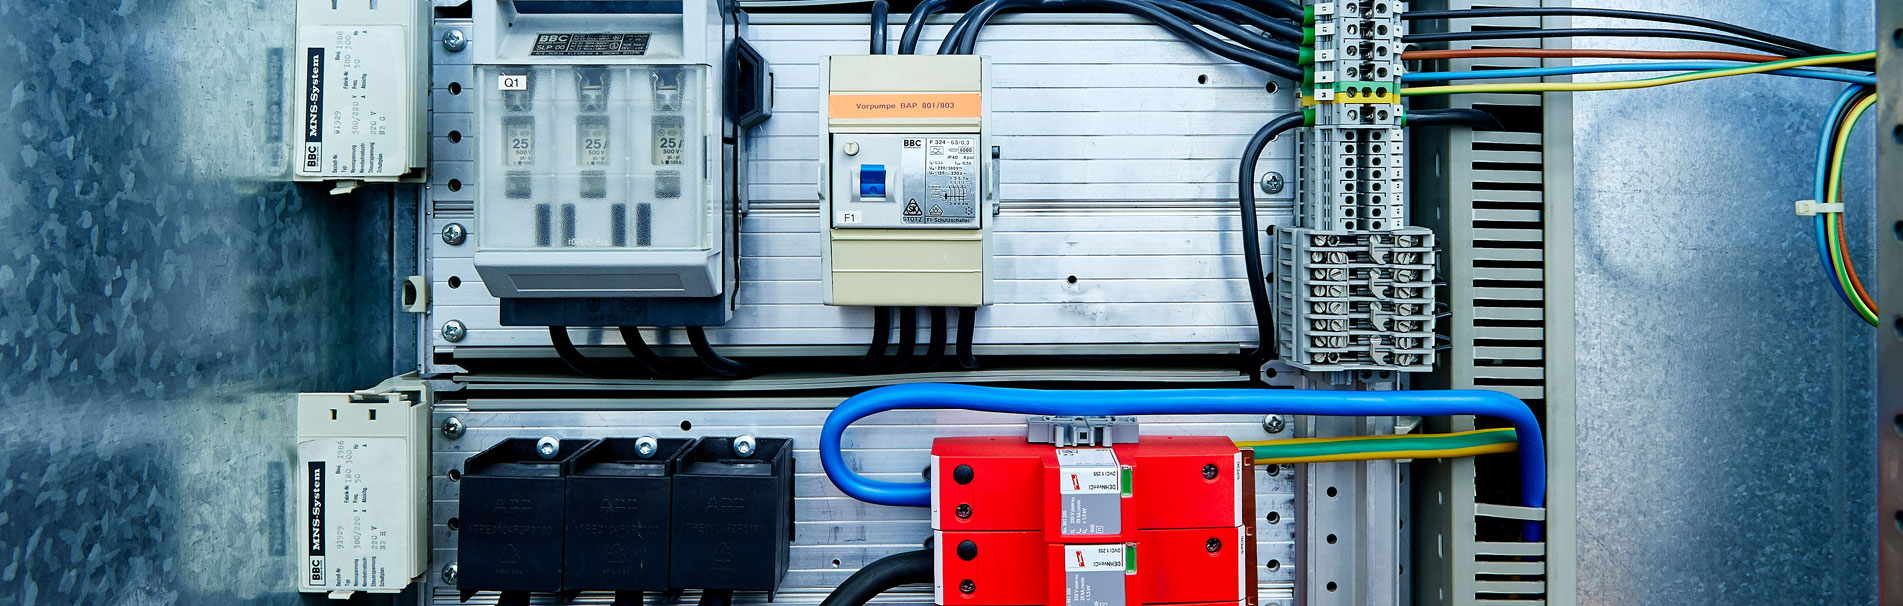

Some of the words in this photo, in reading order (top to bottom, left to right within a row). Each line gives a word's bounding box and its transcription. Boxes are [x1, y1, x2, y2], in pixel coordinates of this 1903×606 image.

[504, 78, 519, 88] Q1
[309, 54, 320, 136] MNS-System
[512, 138, 528, 149] 25
[585, 139, 601, 149] 25
[660, 138, 676, 148] 25
[307, 146, 316, 167] BBC
[313, 468, 322, 550] MNS-System
[354, 516, 362, 549] 380/220
[312, 560, 320, 580] BBC
